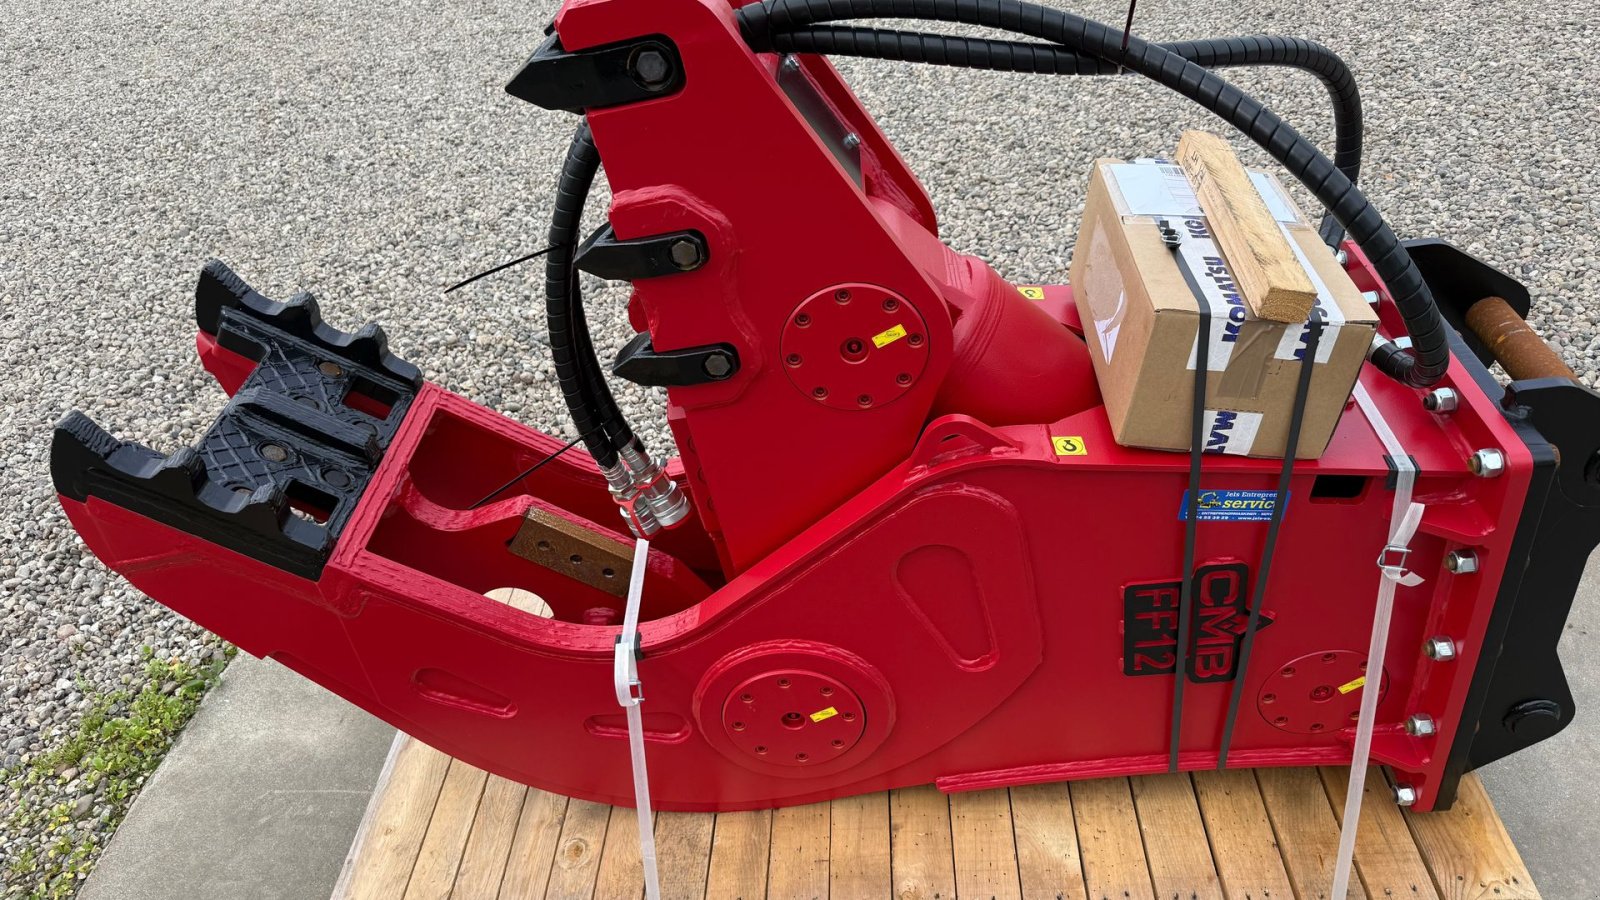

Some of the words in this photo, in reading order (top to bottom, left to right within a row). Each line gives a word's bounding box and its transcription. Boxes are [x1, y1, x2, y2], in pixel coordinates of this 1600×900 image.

[1202, 256, 1246, 342] KOMATSU
[1222, 498, 1275, 509] servic
[1134, 587, 1179, 671] FF12
[1195, 570, 1240, 678] CMB
